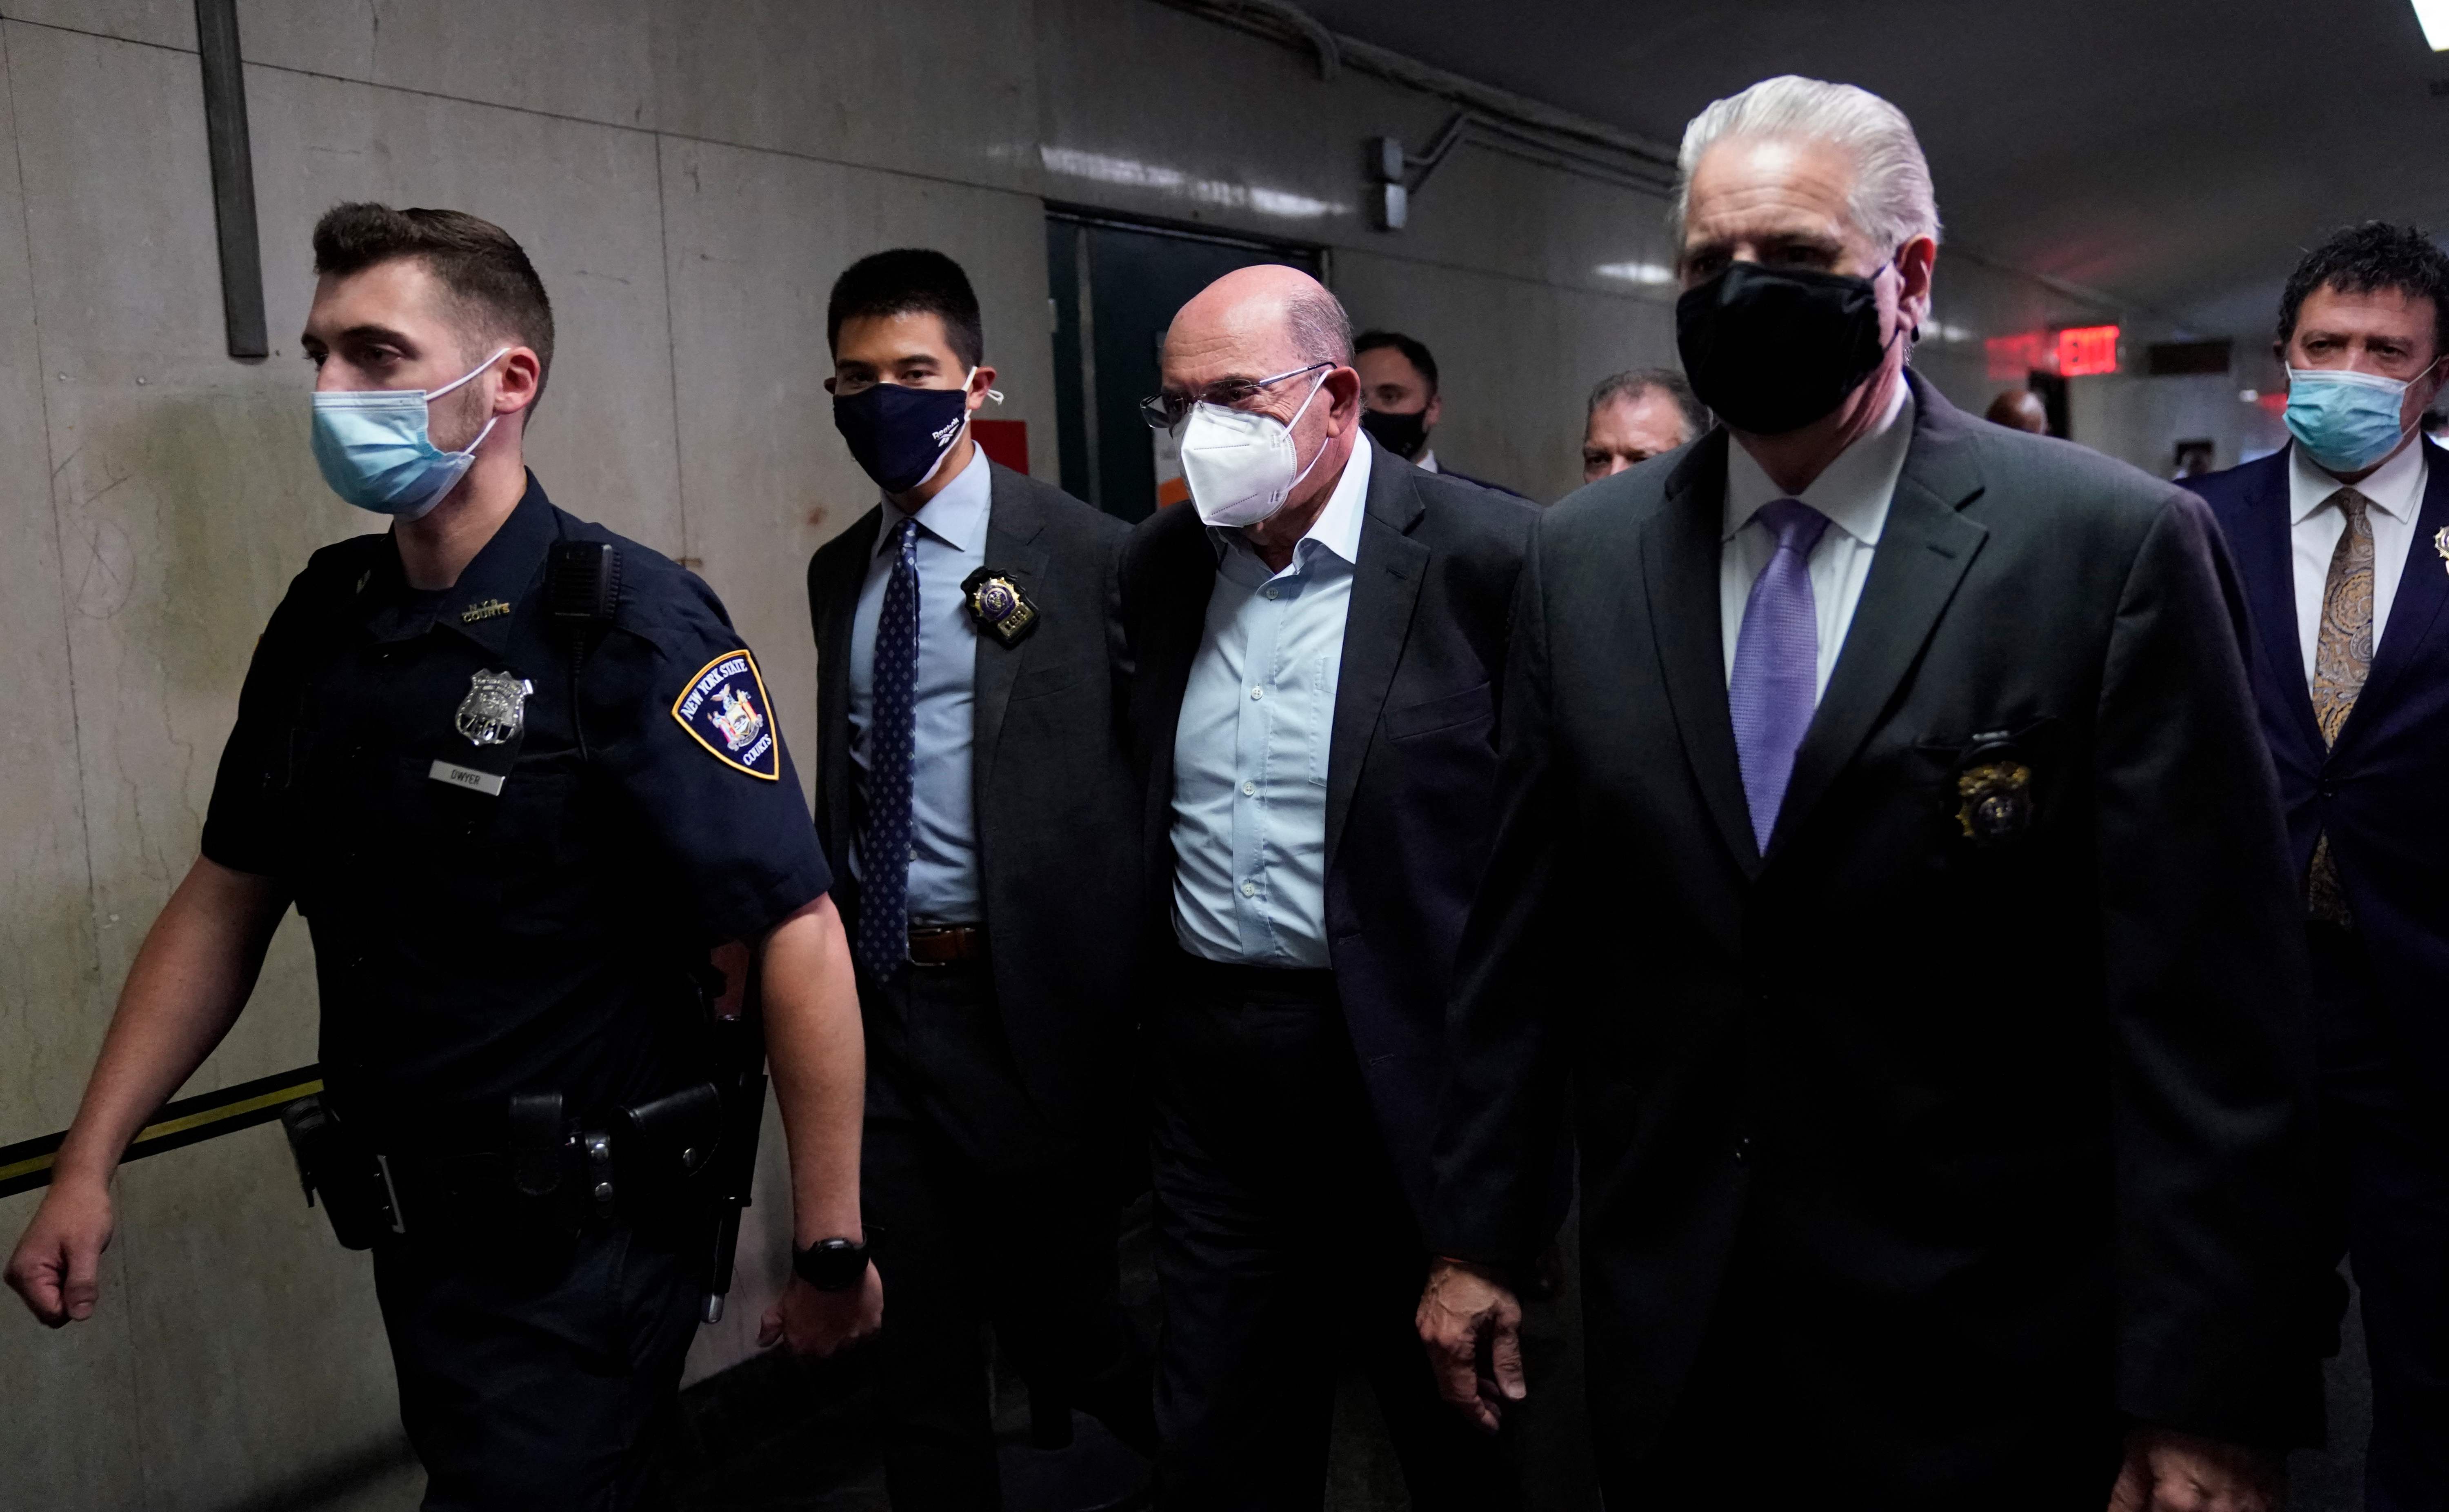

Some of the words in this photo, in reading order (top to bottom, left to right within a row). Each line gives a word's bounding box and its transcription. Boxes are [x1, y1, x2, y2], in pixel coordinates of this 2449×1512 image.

[932, 417, 960, 440] Reebok
[680, 688, 704, 721] NEW
[696, 668, 724, 695] YORK
[719, 658, 748, 678] STATE
[742, 733, 772, 766] COURTS
[451, 769, 481, 785] DWYER
